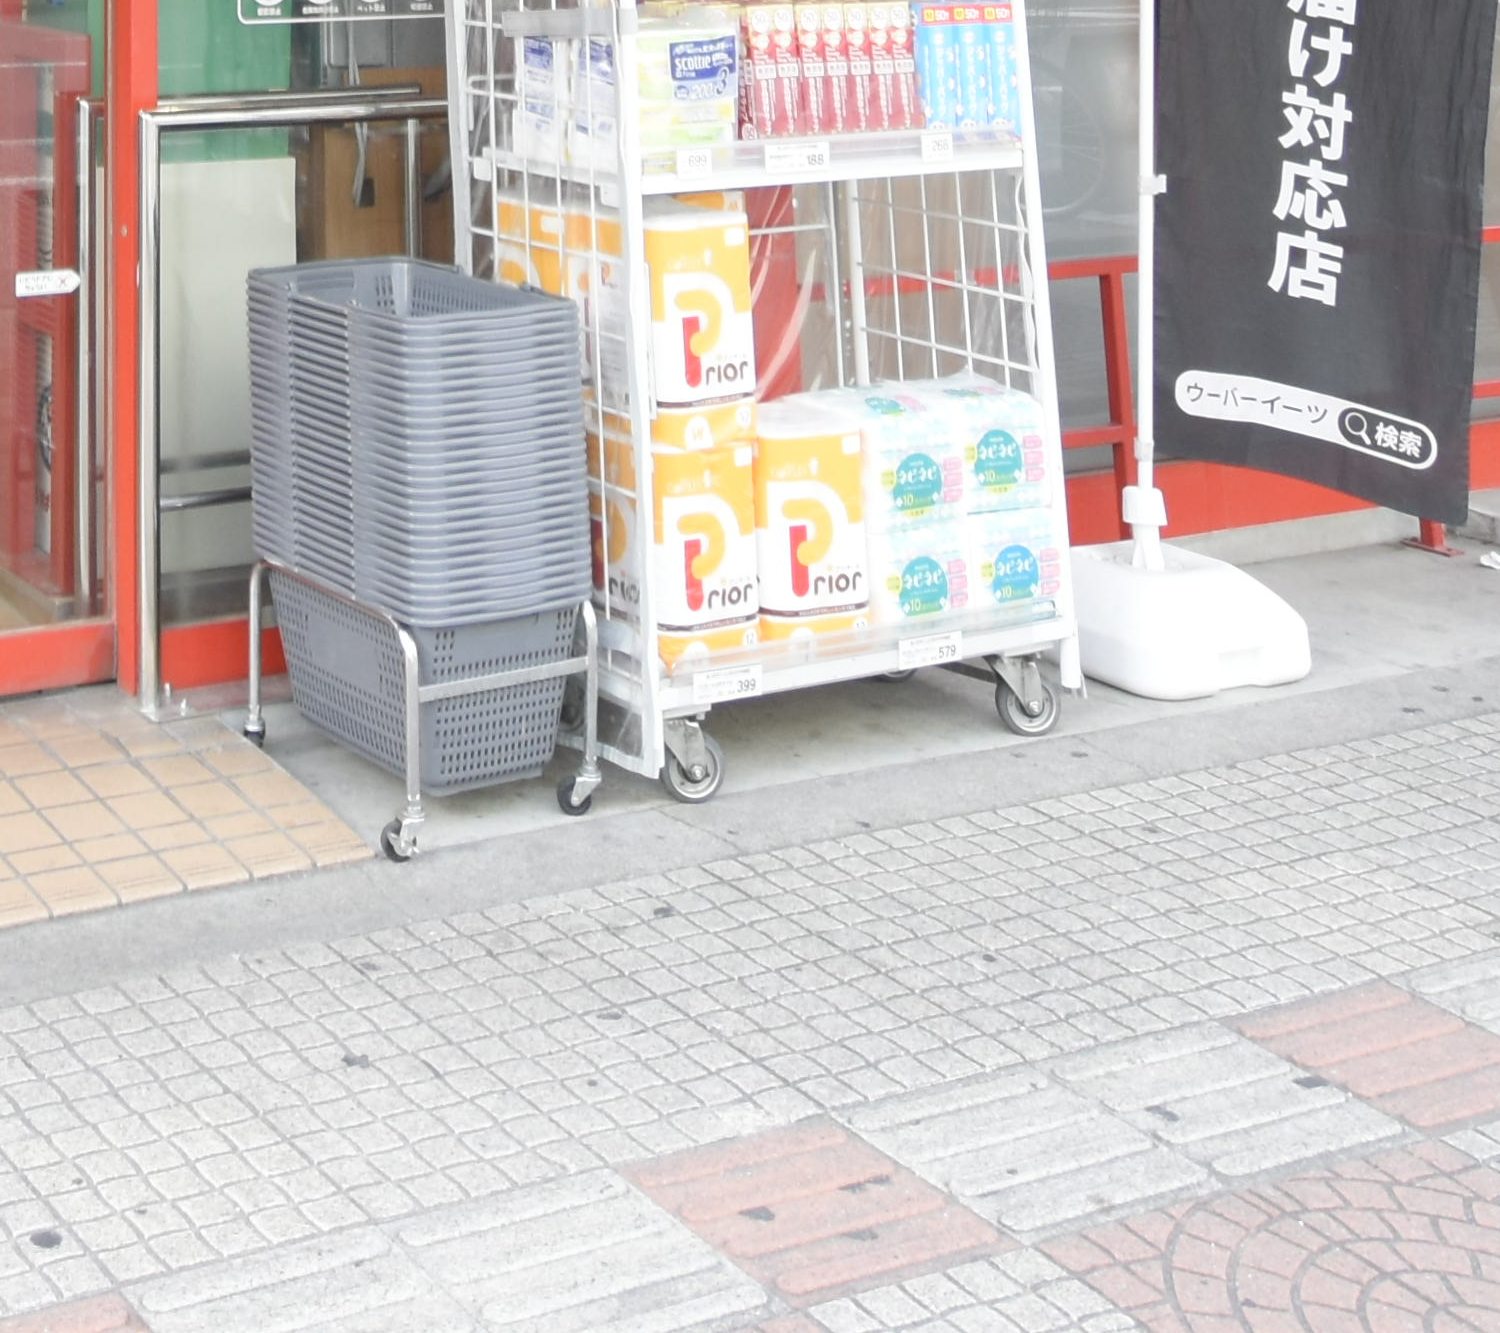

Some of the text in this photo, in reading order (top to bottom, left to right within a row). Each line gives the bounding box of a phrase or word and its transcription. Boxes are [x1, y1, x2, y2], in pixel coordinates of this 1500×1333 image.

[1185, 380, 1329, 426] ウーバーイーツ
[1374, 420, 1424, 459] 検索
[938, 644, 956, 660] 579
[737, 678, 756, 694] 399
